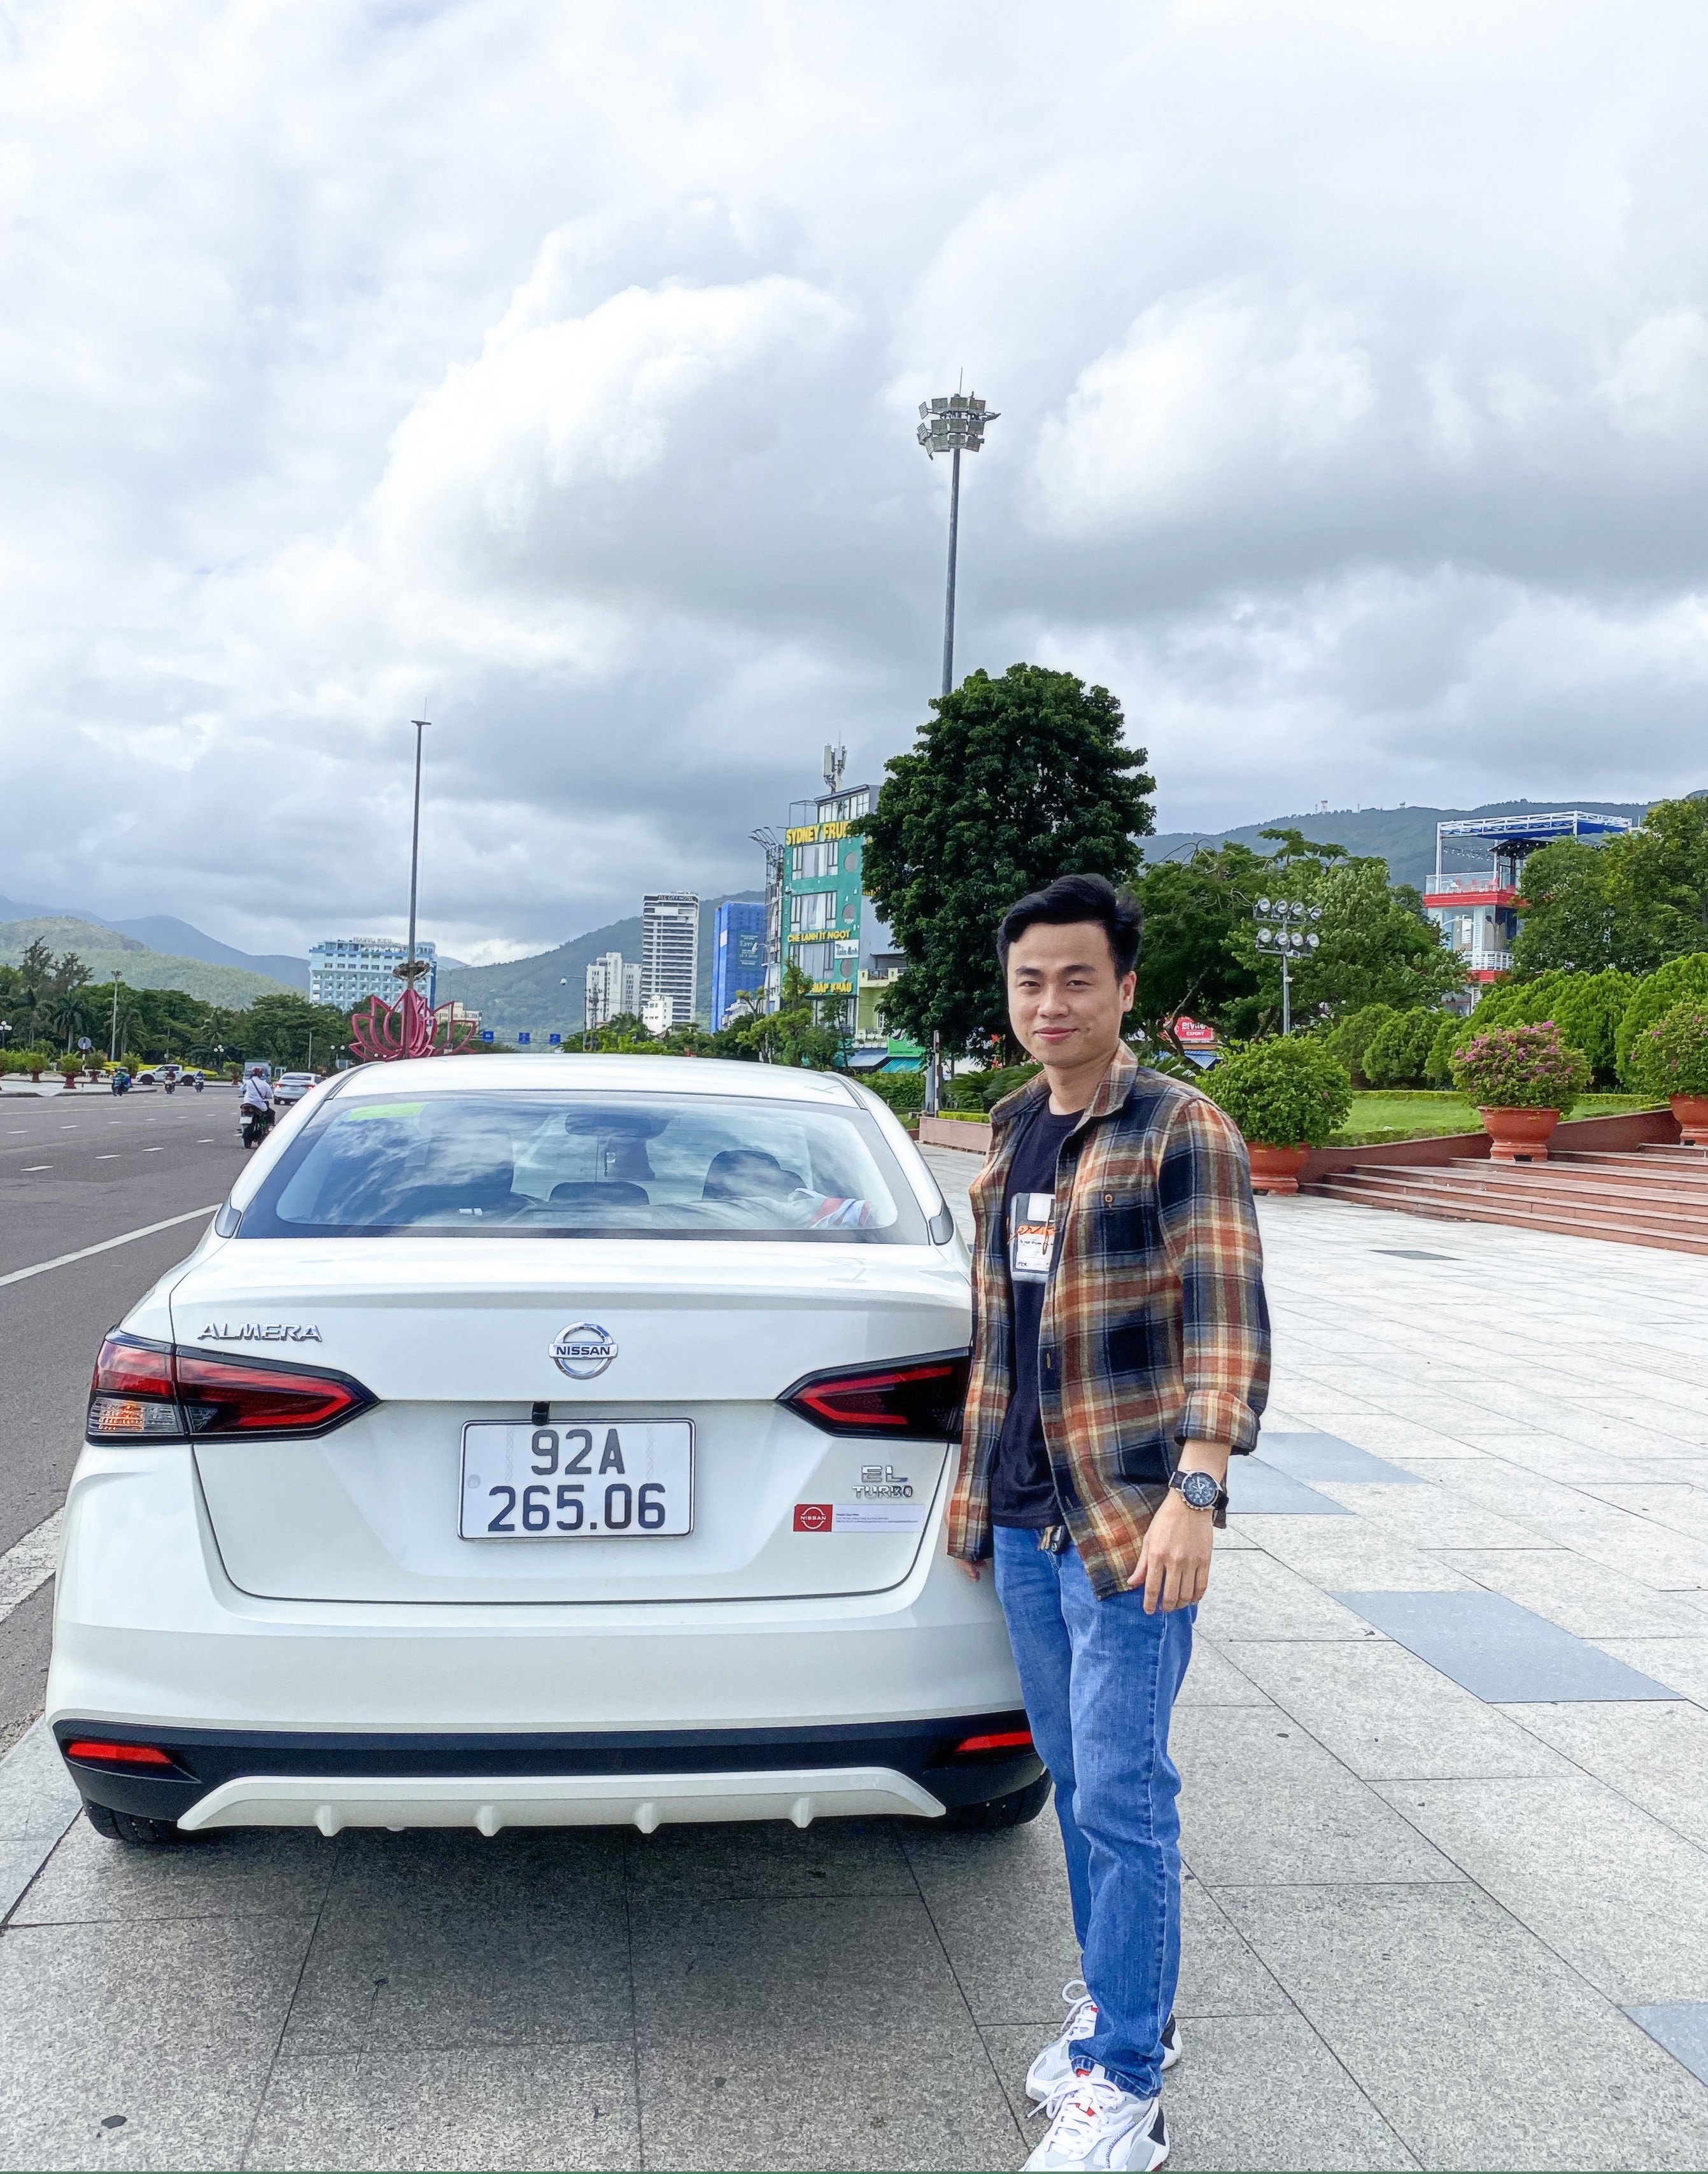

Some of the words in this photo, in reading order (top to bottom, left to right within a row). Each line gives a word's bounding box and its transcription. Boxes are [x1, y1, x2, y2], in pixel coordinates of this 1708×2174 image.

[786, 825, 820, 846] SYDNEY
[801, 933, 818, 943] LẠNH
[827, 929, 850, 941] NGỌT
[197, 1323, 323, 1343] ALMERA
[556, 1346, 610, 1355] NISSAN
[531, 1429, 625, 1476] 92A
[861, 1465, 908, 1483] EL
[852, 1485, 914, 1499] TURBO
[488, 1483, 666, 1532] 265.06
